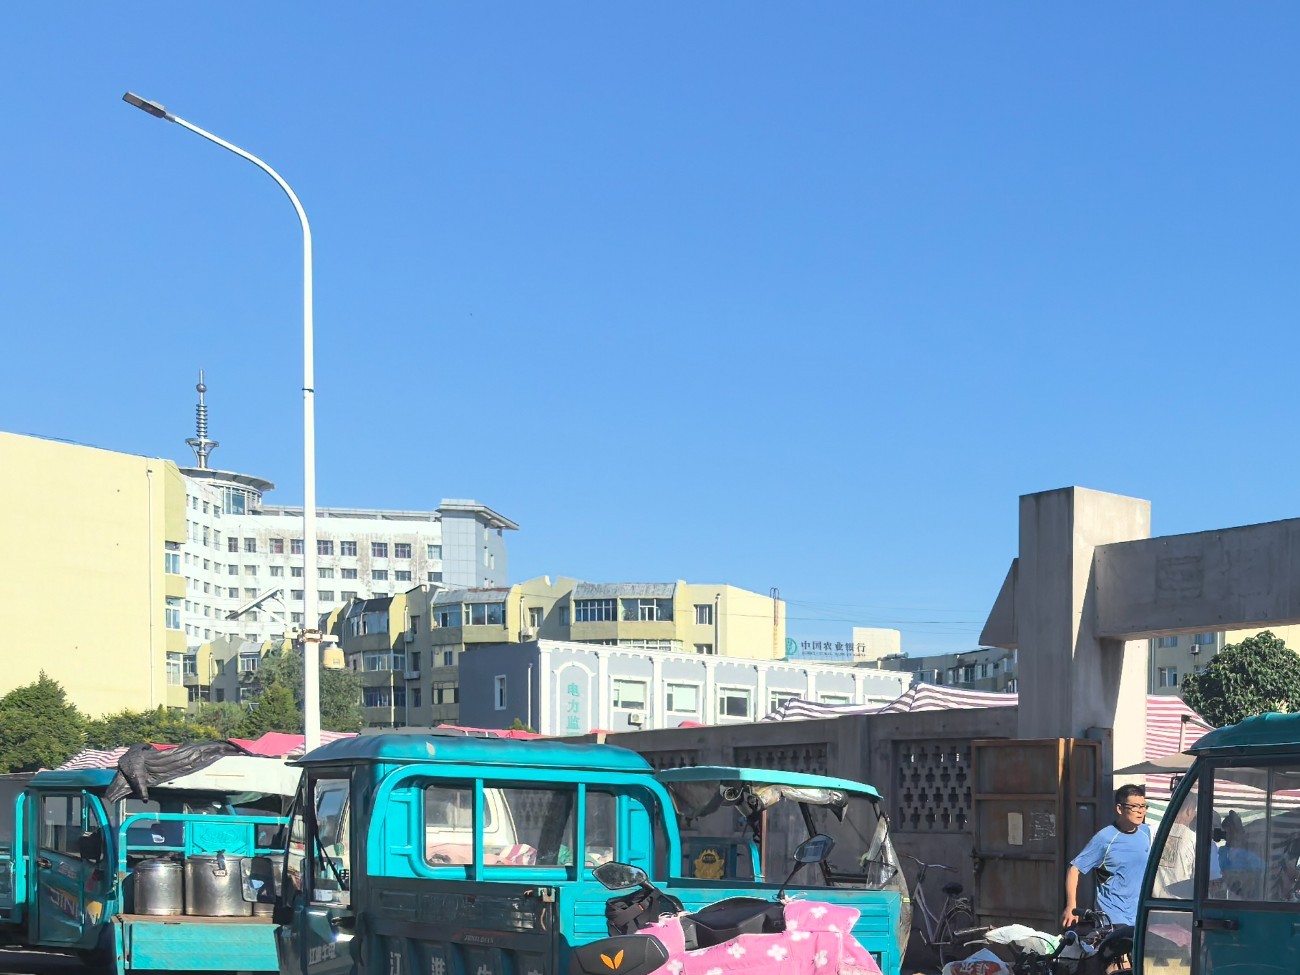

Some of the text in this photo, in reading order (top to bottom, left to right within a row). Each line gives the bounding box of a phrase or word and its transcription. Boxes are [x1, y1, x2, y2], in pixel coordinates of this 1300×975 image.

[801, 640, 866, 653] 中国农业银行
[567, 683, 580, 735] 电力监
